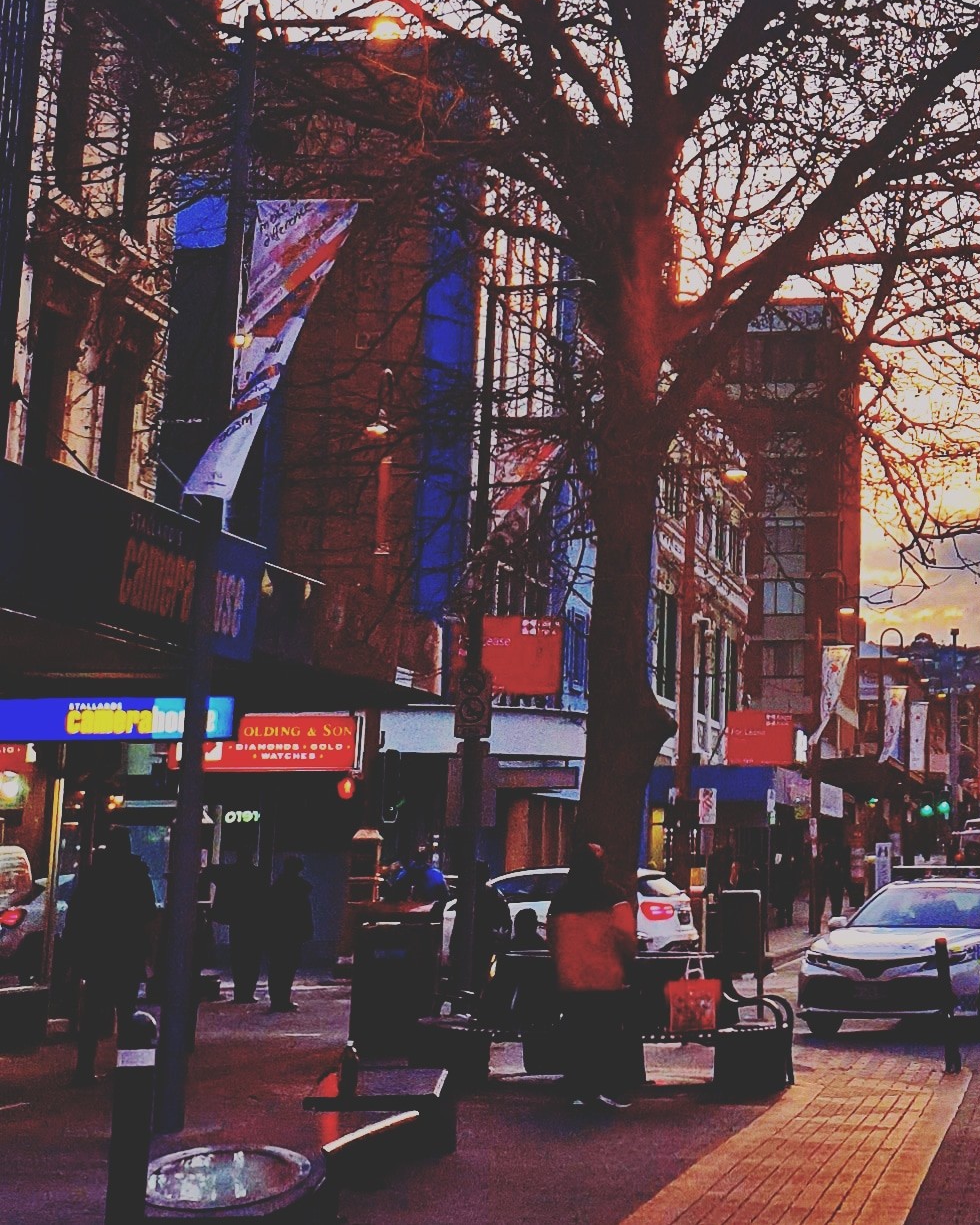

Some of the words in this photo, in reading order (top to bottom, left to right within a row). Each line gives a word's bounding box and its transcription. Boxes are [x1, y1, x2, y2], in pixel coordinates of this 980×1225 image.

[483, 637, 511, 647] ease
[307, 728, 317, 737] &
[235, 743, 300, 751] DIAMONDS
[310, 743, 343, 751] GOLD
